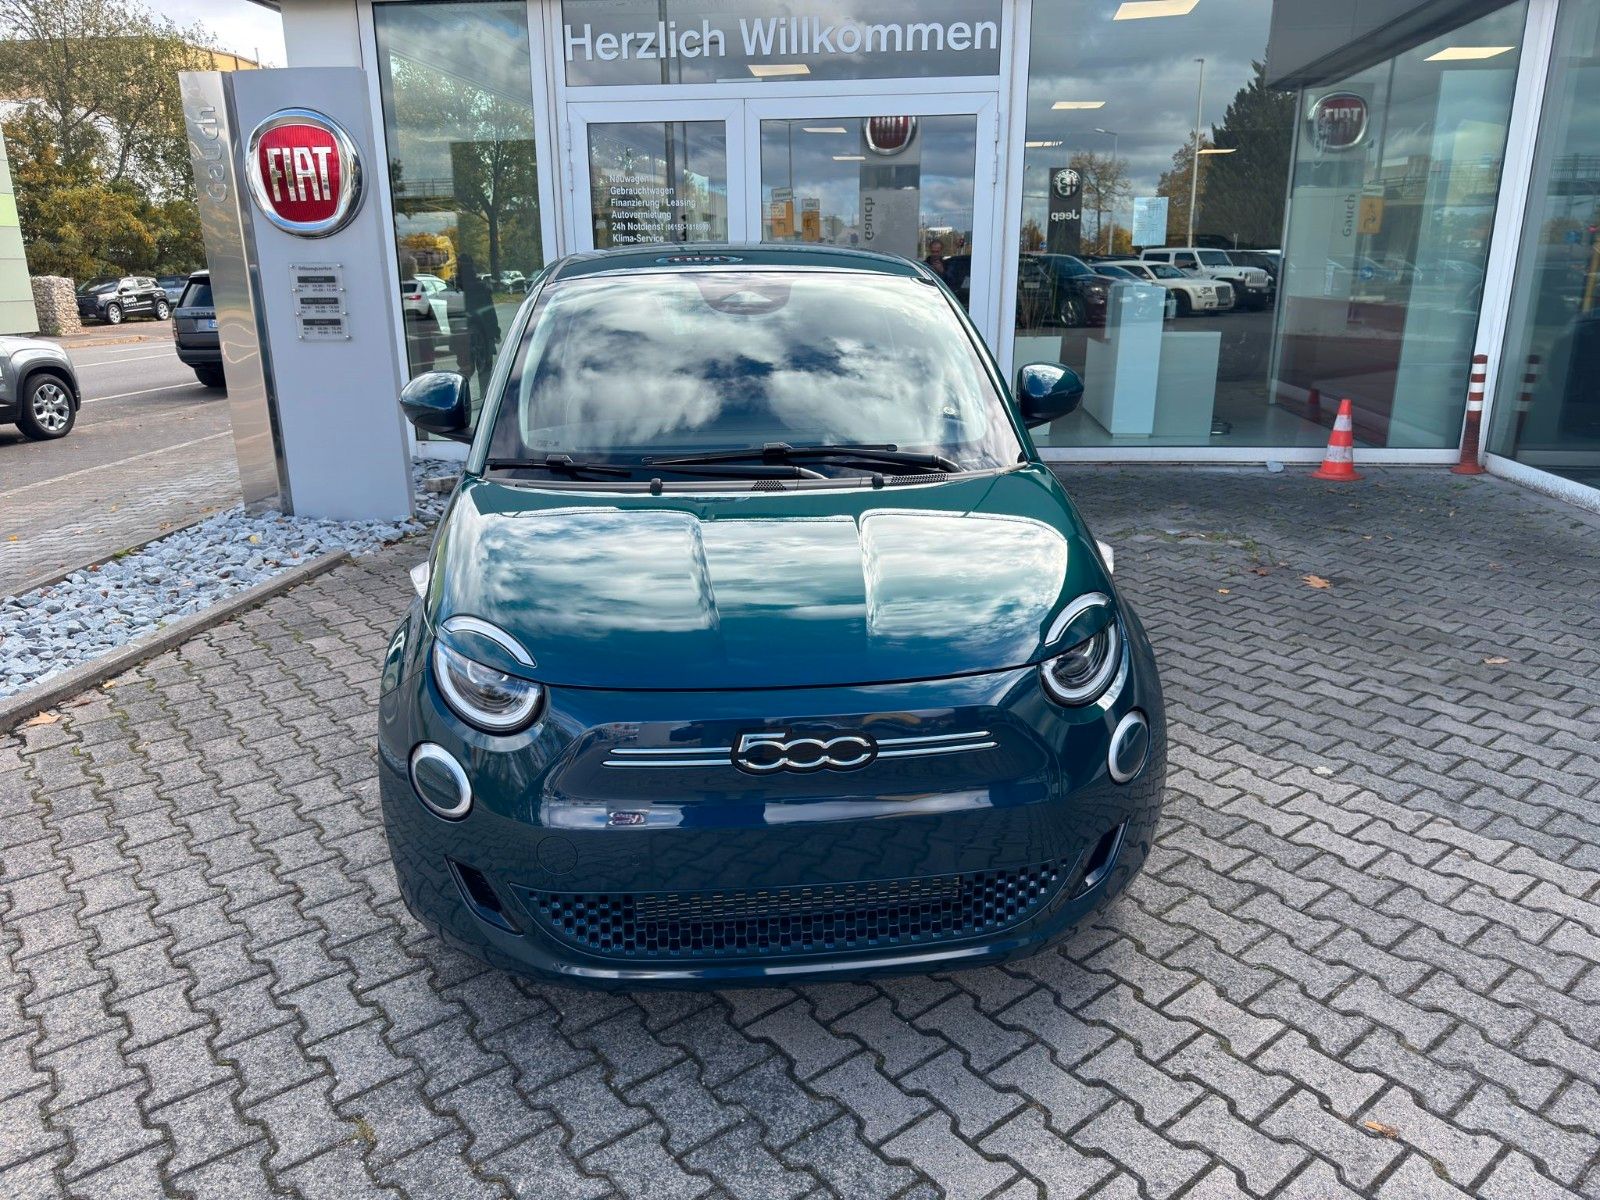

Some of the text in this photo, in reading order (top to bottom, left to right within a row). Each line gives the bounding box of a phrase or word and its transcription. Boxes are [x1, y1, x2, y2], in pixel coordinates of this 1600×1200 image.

[564, 15, 998, 62] Herzlich Willkommen
[266, 146, 332, 202] FIAT
[609, 175, 651, 184] Neuwagen
[610, 187, 674, 196] Gebrauchtwagen
[610, 198, 660, 208] Finanzierung
[666, 199, 697, 209] Leasing
[611, 210, 672, 220] Autovermietung
[612, 222, 626, 231] 24h
[627, 221, 664, 231] Notdienst
[612, 234, 664, 243] Klima-Service
[736, 731, 872, 771] 500
